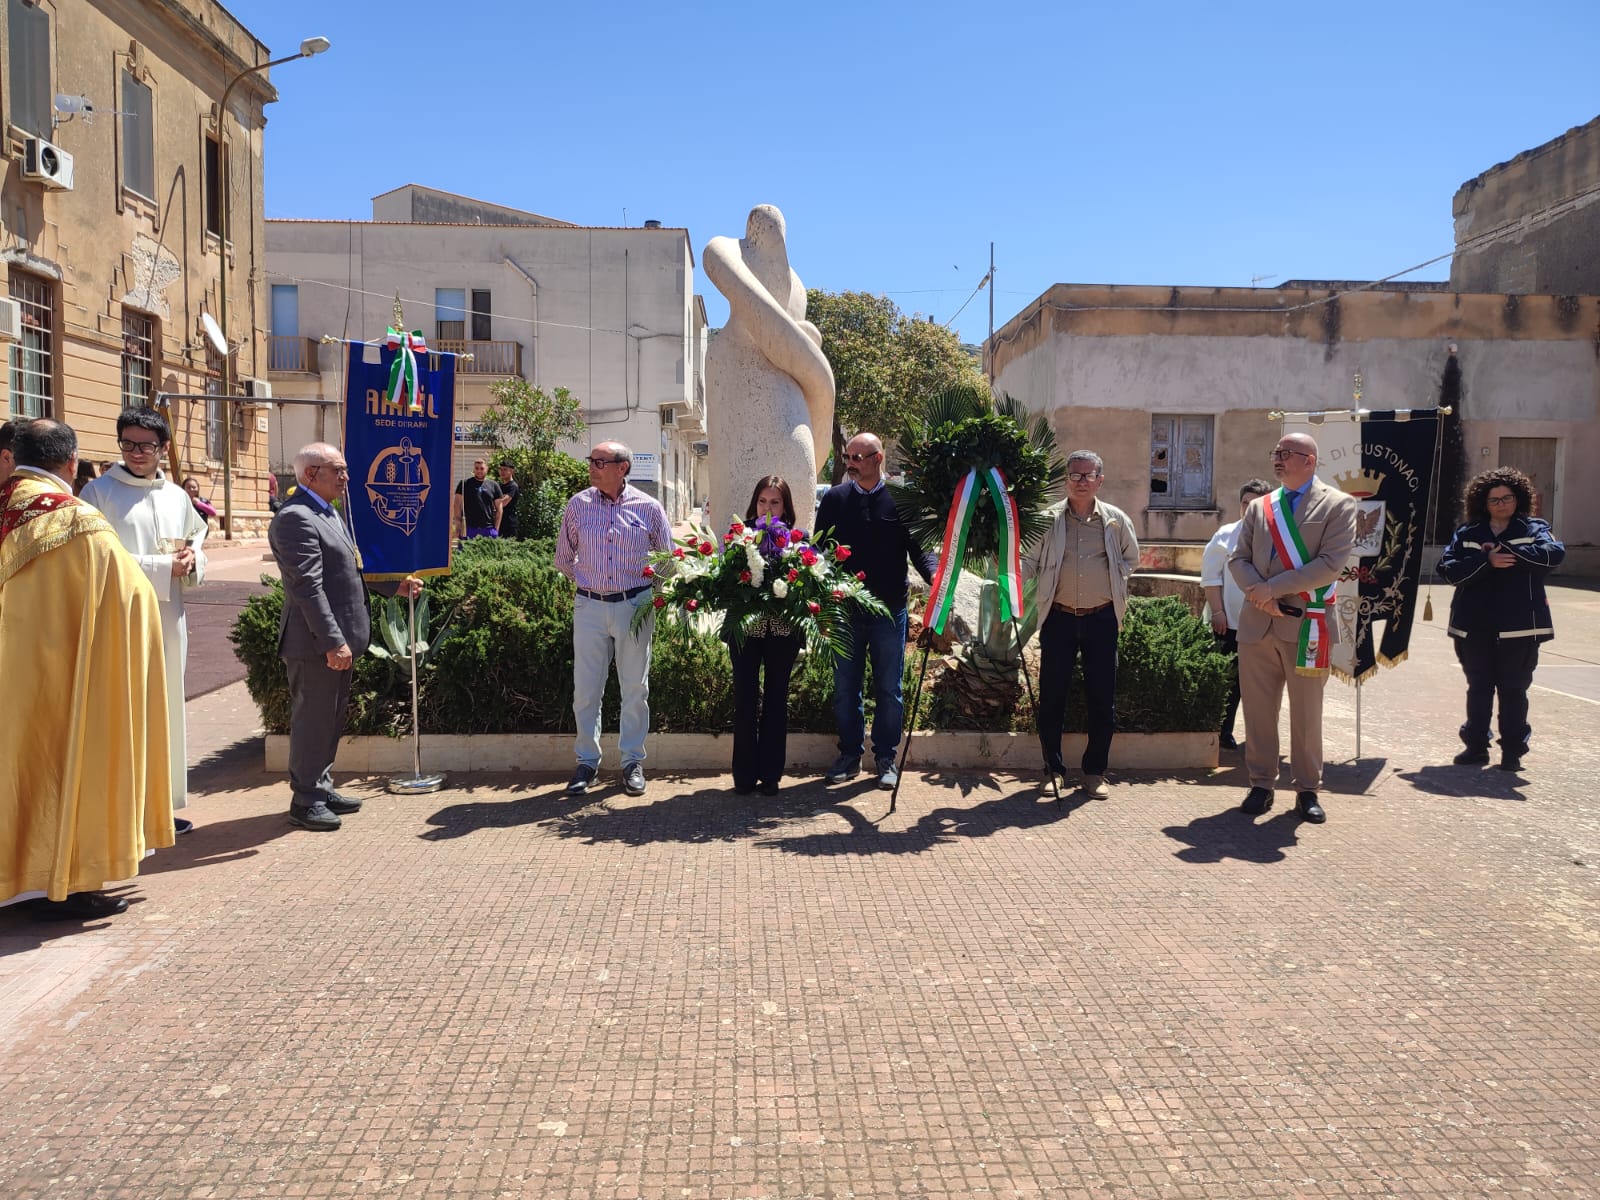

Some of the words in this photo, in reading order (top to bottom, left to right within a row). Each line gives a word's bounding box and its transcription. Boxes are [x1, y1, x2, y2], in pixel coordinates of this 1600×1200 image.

[375, 419, 396, 427] SEDE
[1330, 446, 1346, 461] DI
[1352, 443, 1420, 493] CUSTONACI
